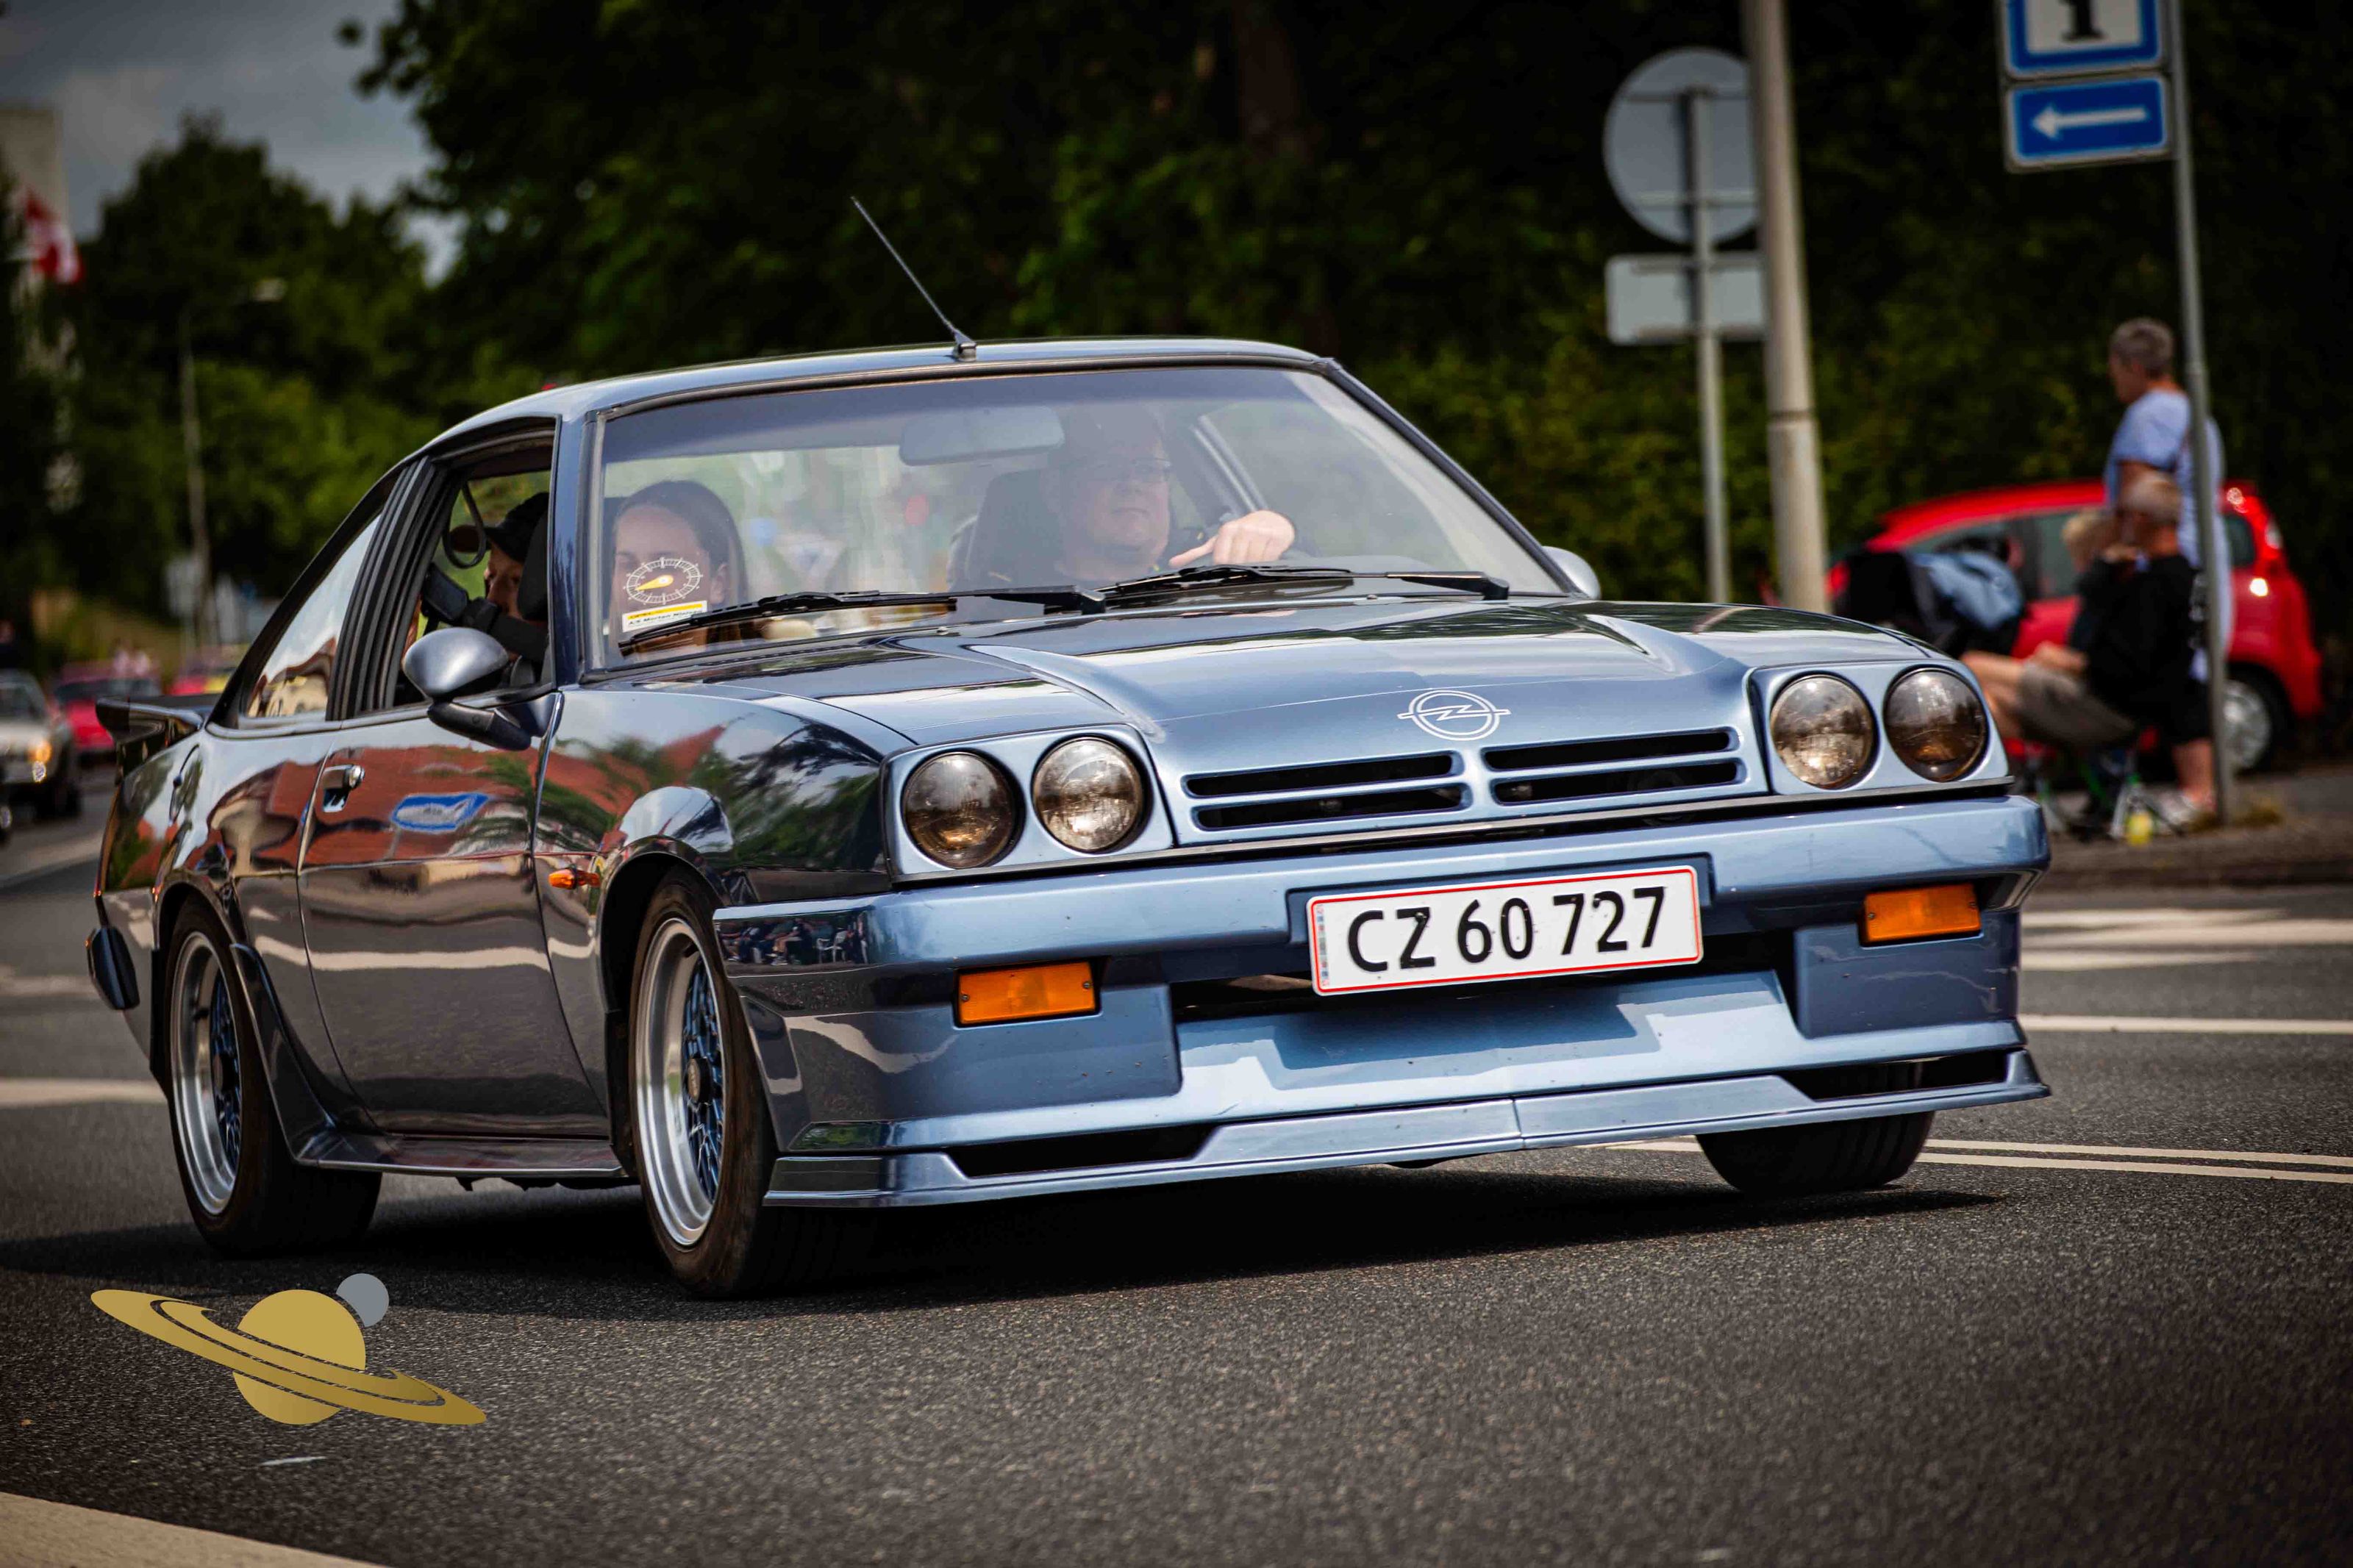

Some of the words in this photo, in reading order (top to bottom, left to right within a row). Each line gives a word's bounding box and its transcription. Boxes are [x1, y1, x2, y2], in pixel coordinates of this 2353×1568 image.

[1347, 906, 1435, 973] CZ
[1457, 897, 1534, 964] 60
[1552, 886, 1665, 956] 727
